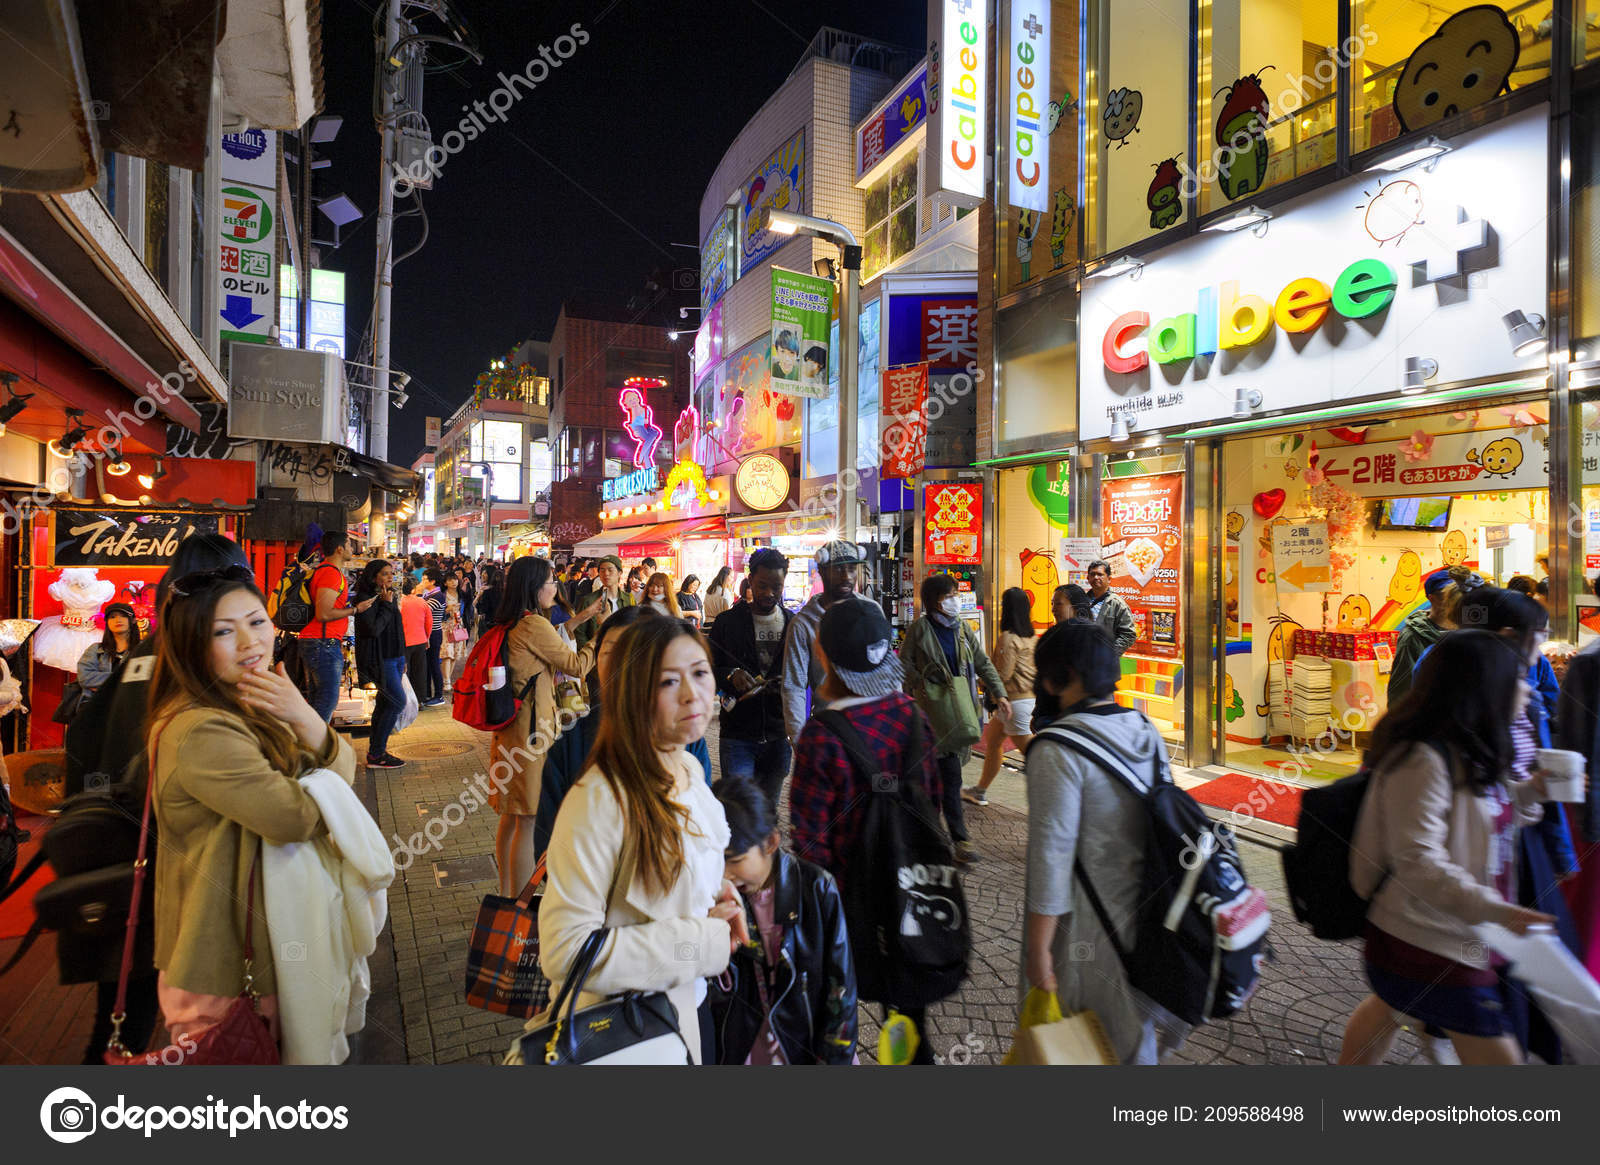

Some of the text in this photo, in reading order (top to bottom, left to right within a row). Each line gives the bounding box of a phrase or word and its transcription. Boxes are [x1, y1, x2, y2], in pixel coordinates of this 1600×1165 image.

[241, 250, 269, 274] 酒
[223, 277, 270, 295] のビル
[232, 384, 321, 409] Sun Style
[1352, 453, 1397, 484] 2階
[614, 466, 657, 499] BURLESQUE
[1290, 527, 1310, 537] 2階
[62, 615, 82, 626] SALE
